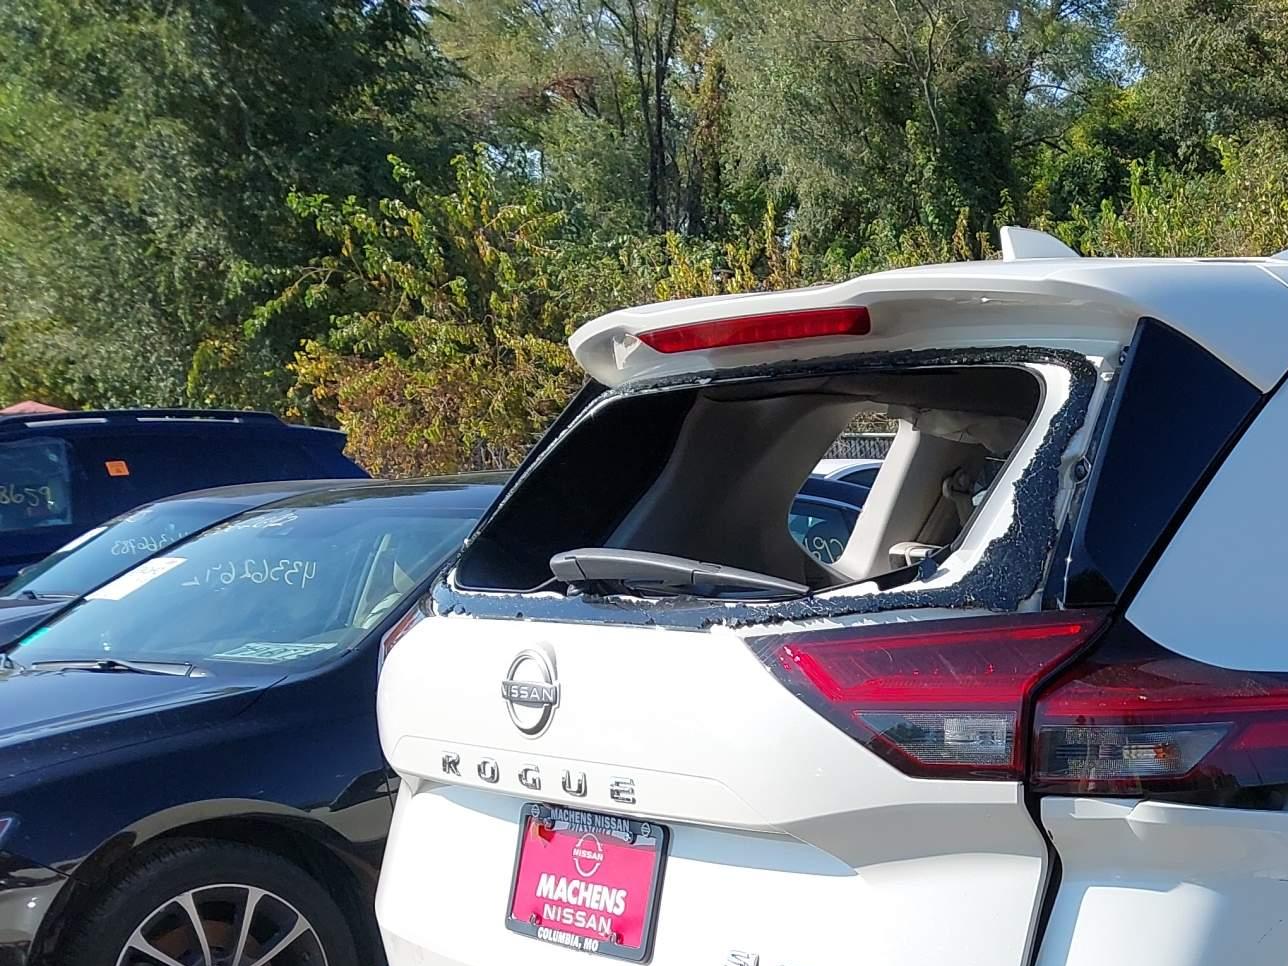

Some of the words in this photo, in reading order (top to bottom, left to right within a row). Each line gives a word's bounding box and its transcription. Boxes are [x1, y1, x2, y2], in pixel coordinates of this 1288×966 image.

[502, 682, 556, 702] NISSAN
[441, 751, 636, 805] ROGUE
[550, 807, 593, 827] MACHENS
[594, 814, 630, 833] NISSAN
[573, 848, 604, 861] NISSAN
[536, 873, 627, 916] MACHENS
[543, 903, 614, 936] NISSAN
[537, 926, 583, 949] COLUMBIA,
[583, 934, 599, 951] MO
